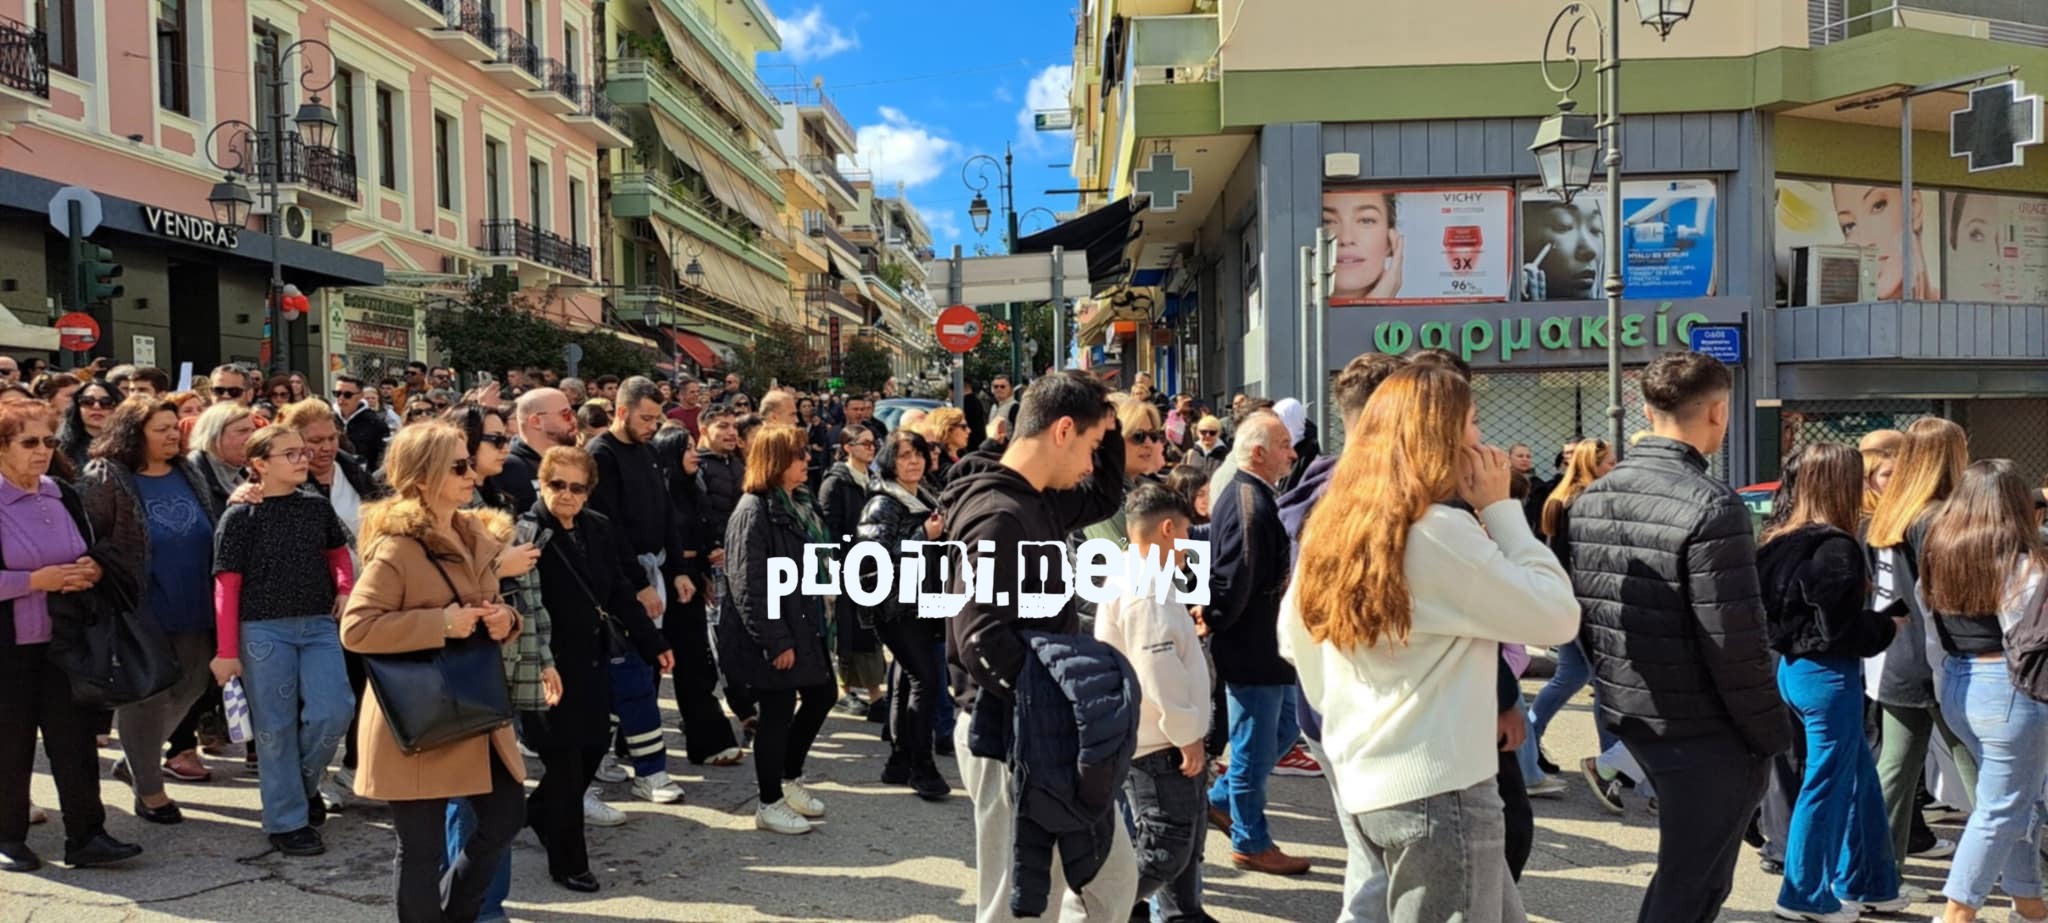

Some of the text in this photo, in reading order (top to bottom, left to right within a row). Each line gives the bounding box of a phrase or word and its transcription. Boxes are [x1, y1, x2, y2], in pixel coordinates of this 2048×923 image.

[1443, 193, 1482, 201] VICHY
[146, 206, 240, 249] VENDRAS
[1453, 258, 1472, 270] 3X
